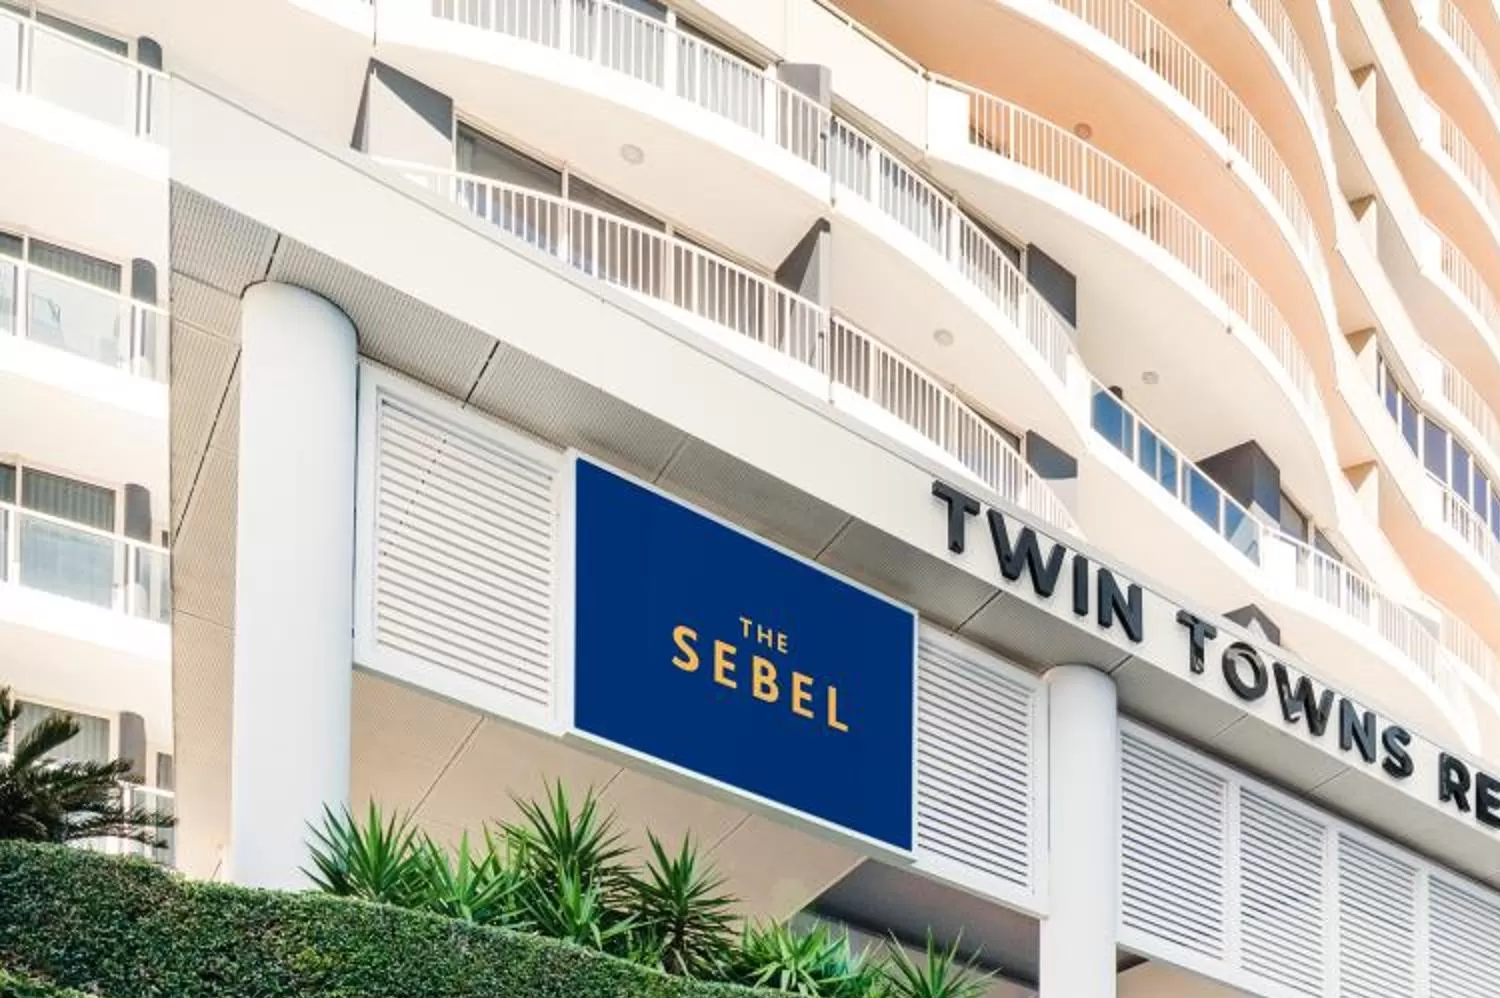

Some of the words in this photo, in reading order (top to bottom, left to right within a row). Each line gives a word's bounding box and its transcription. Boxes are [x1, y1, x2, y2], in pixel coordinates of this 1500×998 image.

[671, 625, 849, 732] SEBEL
[739, 617, 787, 654] THE
[931, 479, 1143, 643] TWIN
[1175, 609, 1415, 779] TOWNS
